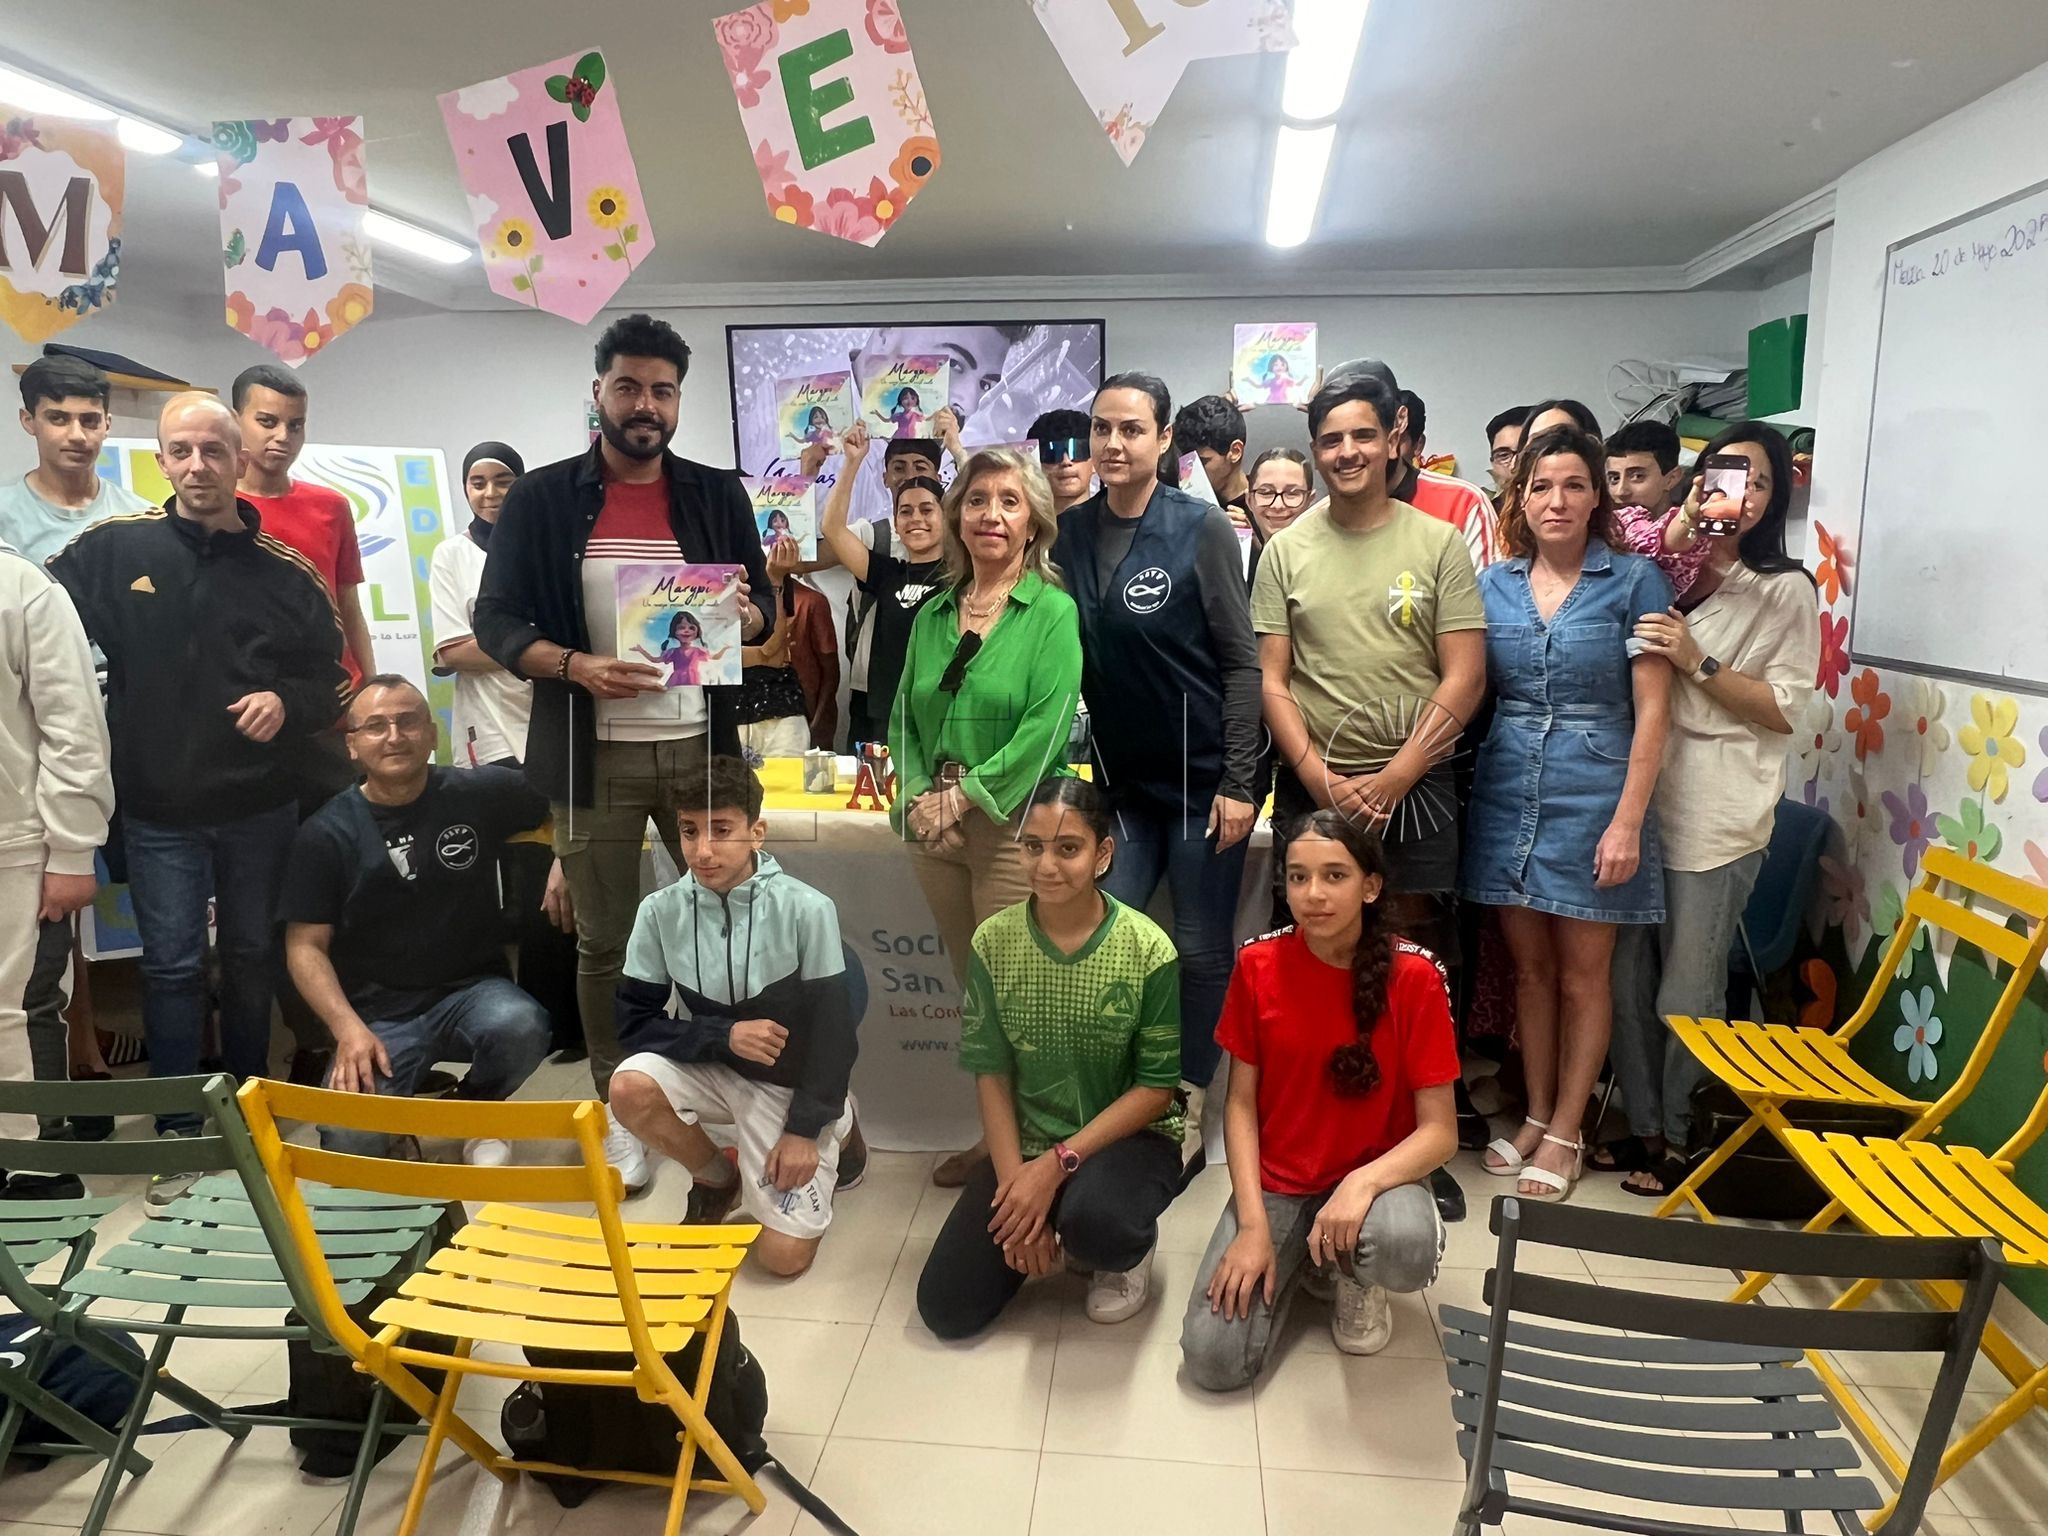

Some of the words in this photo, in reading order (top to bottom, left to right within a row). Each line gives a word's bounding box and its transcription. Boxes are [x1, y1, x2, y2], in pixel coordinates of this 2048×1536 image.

[255, 181, 328, 281] A
[507, 121, 573, 240] V
[778, 29, 875, 170] E
[1932, 249, 1949, 276] 20
[652, 575, 712, 605] Marypi
[881, 967, 945, 994] San
[889, 1004, 917, 1018] Las
